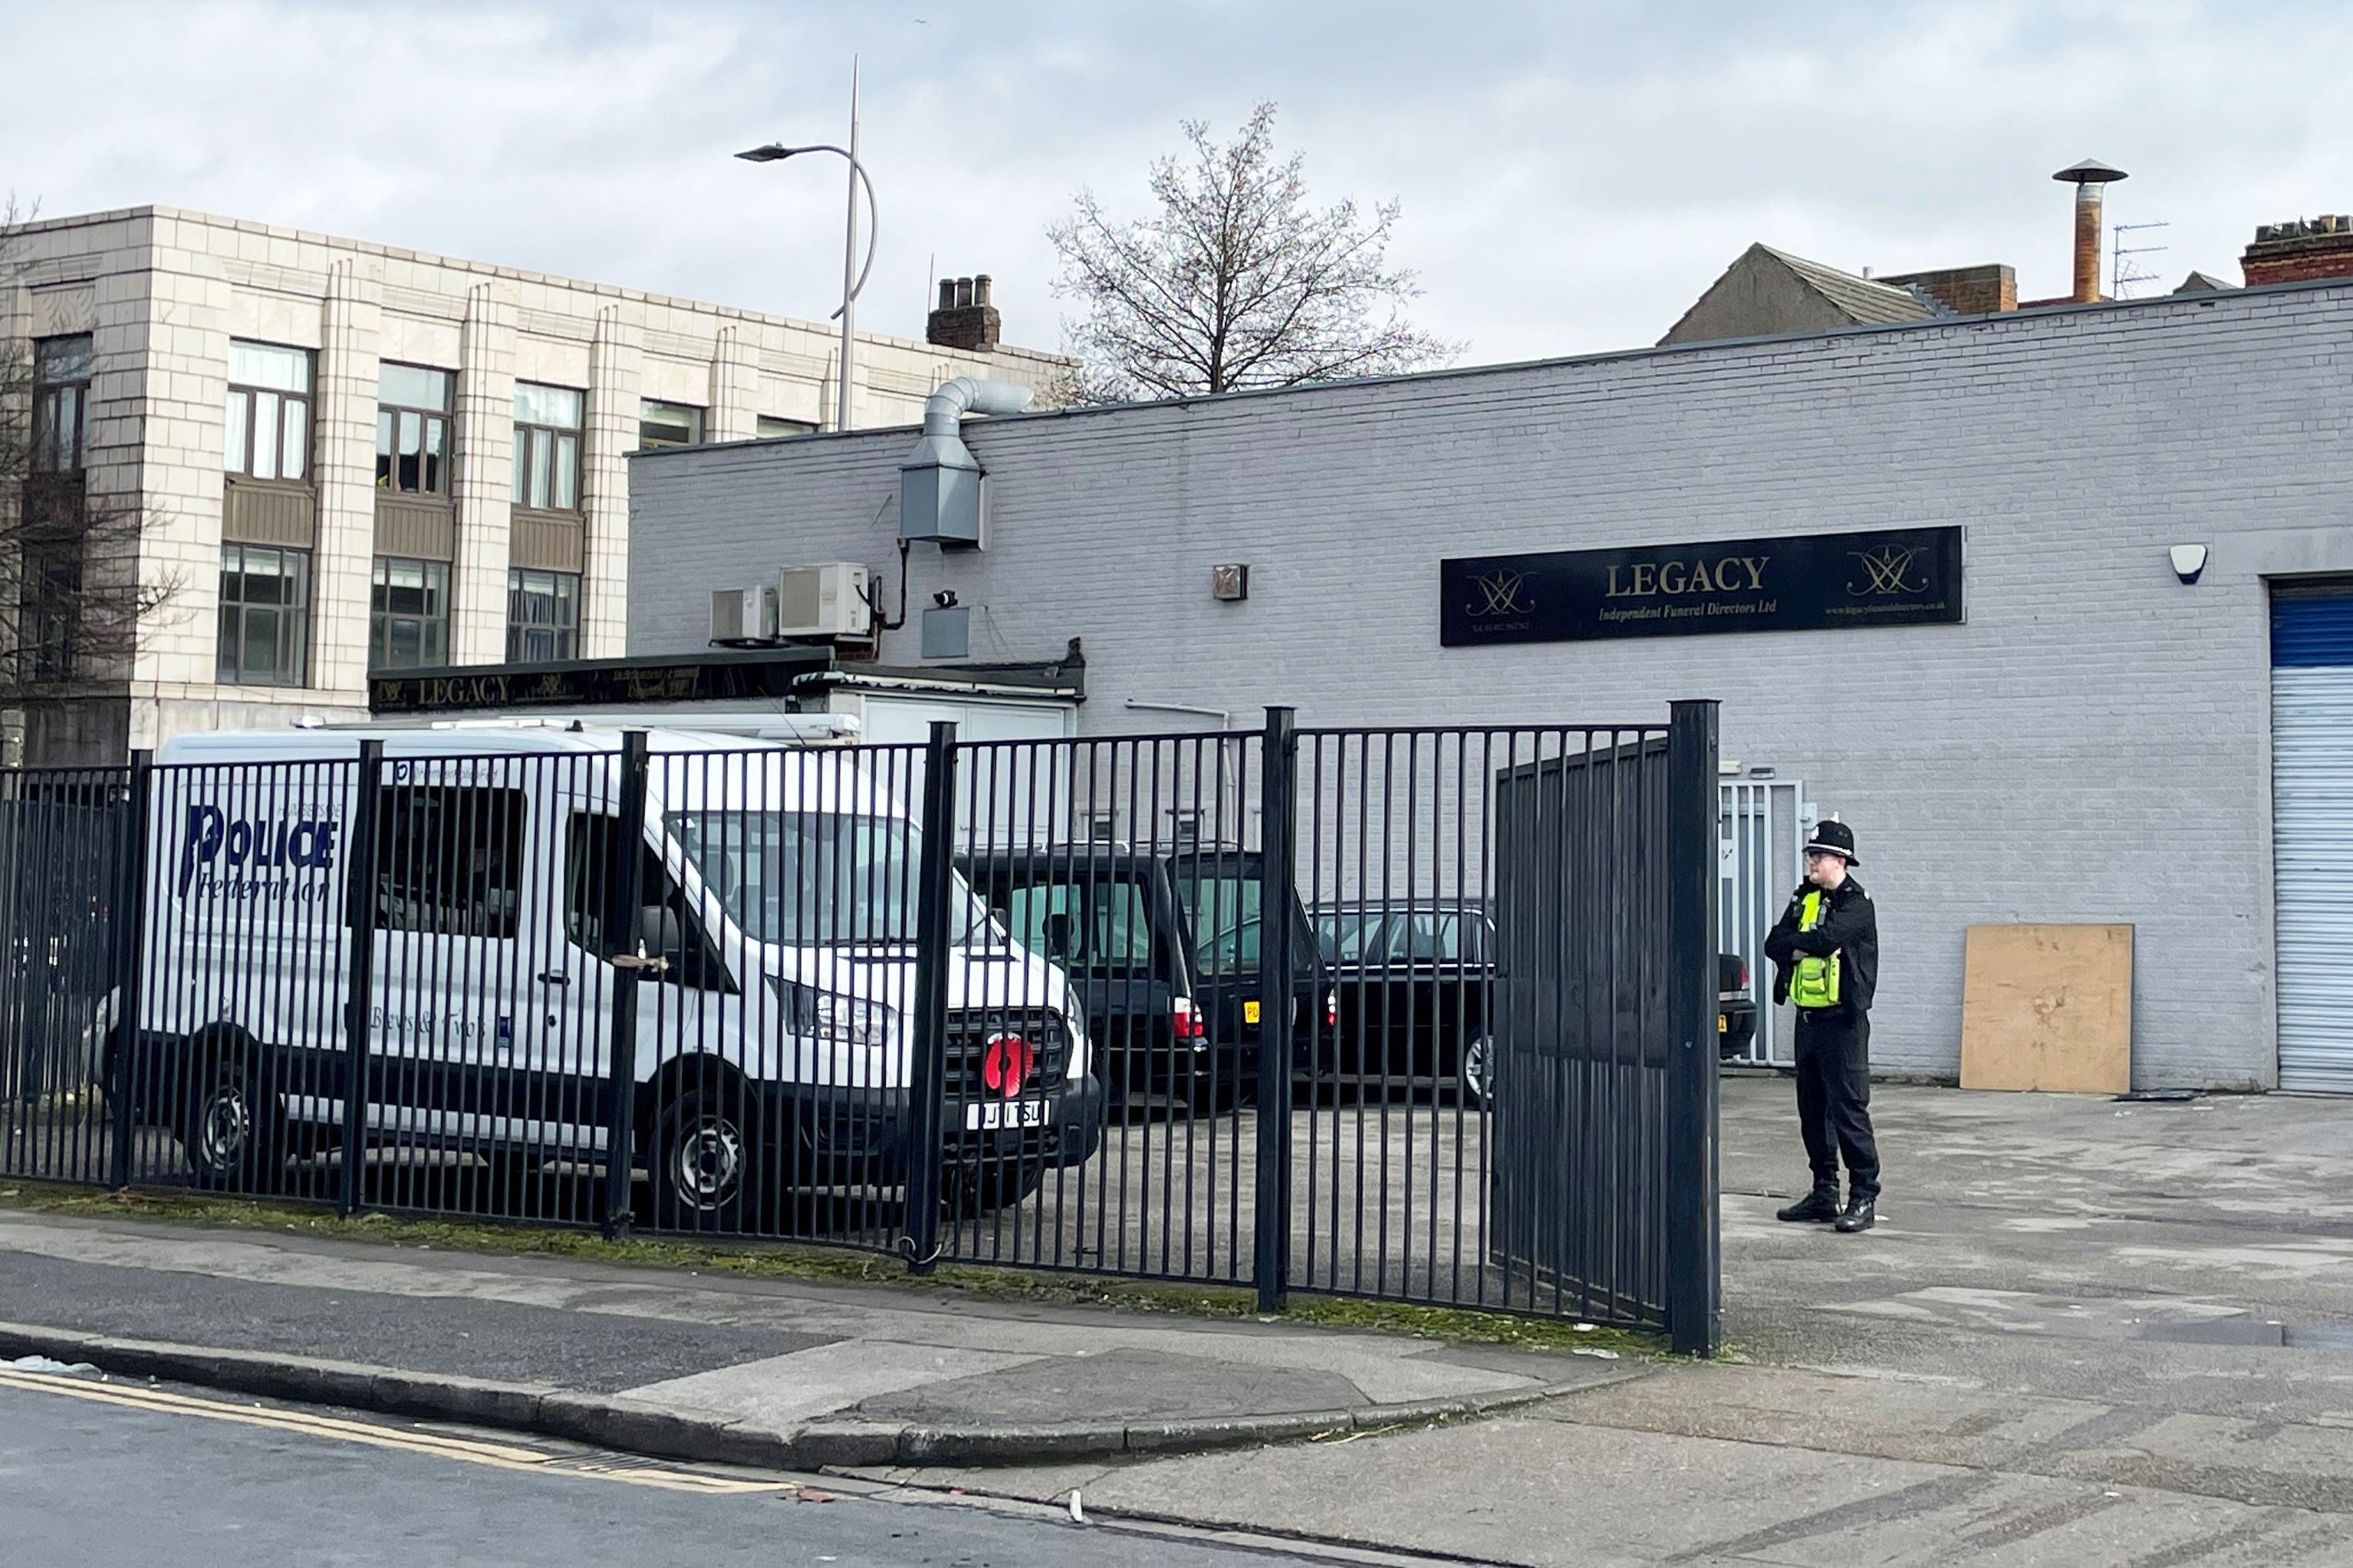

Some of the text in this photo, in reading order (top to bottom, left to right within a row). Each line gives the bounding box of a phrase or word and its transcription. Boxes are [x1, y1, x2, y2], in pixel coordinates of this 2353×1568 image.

[1605, 556, 1771, 597] LEGACY
[1598, 598, 1778, 623] Independent Funeral Directors Ltd
[418, 675, 511, 704] LEGACY
[178, 804, 339, 899] POLICE
[198, 872, 333, 903] Federaton
